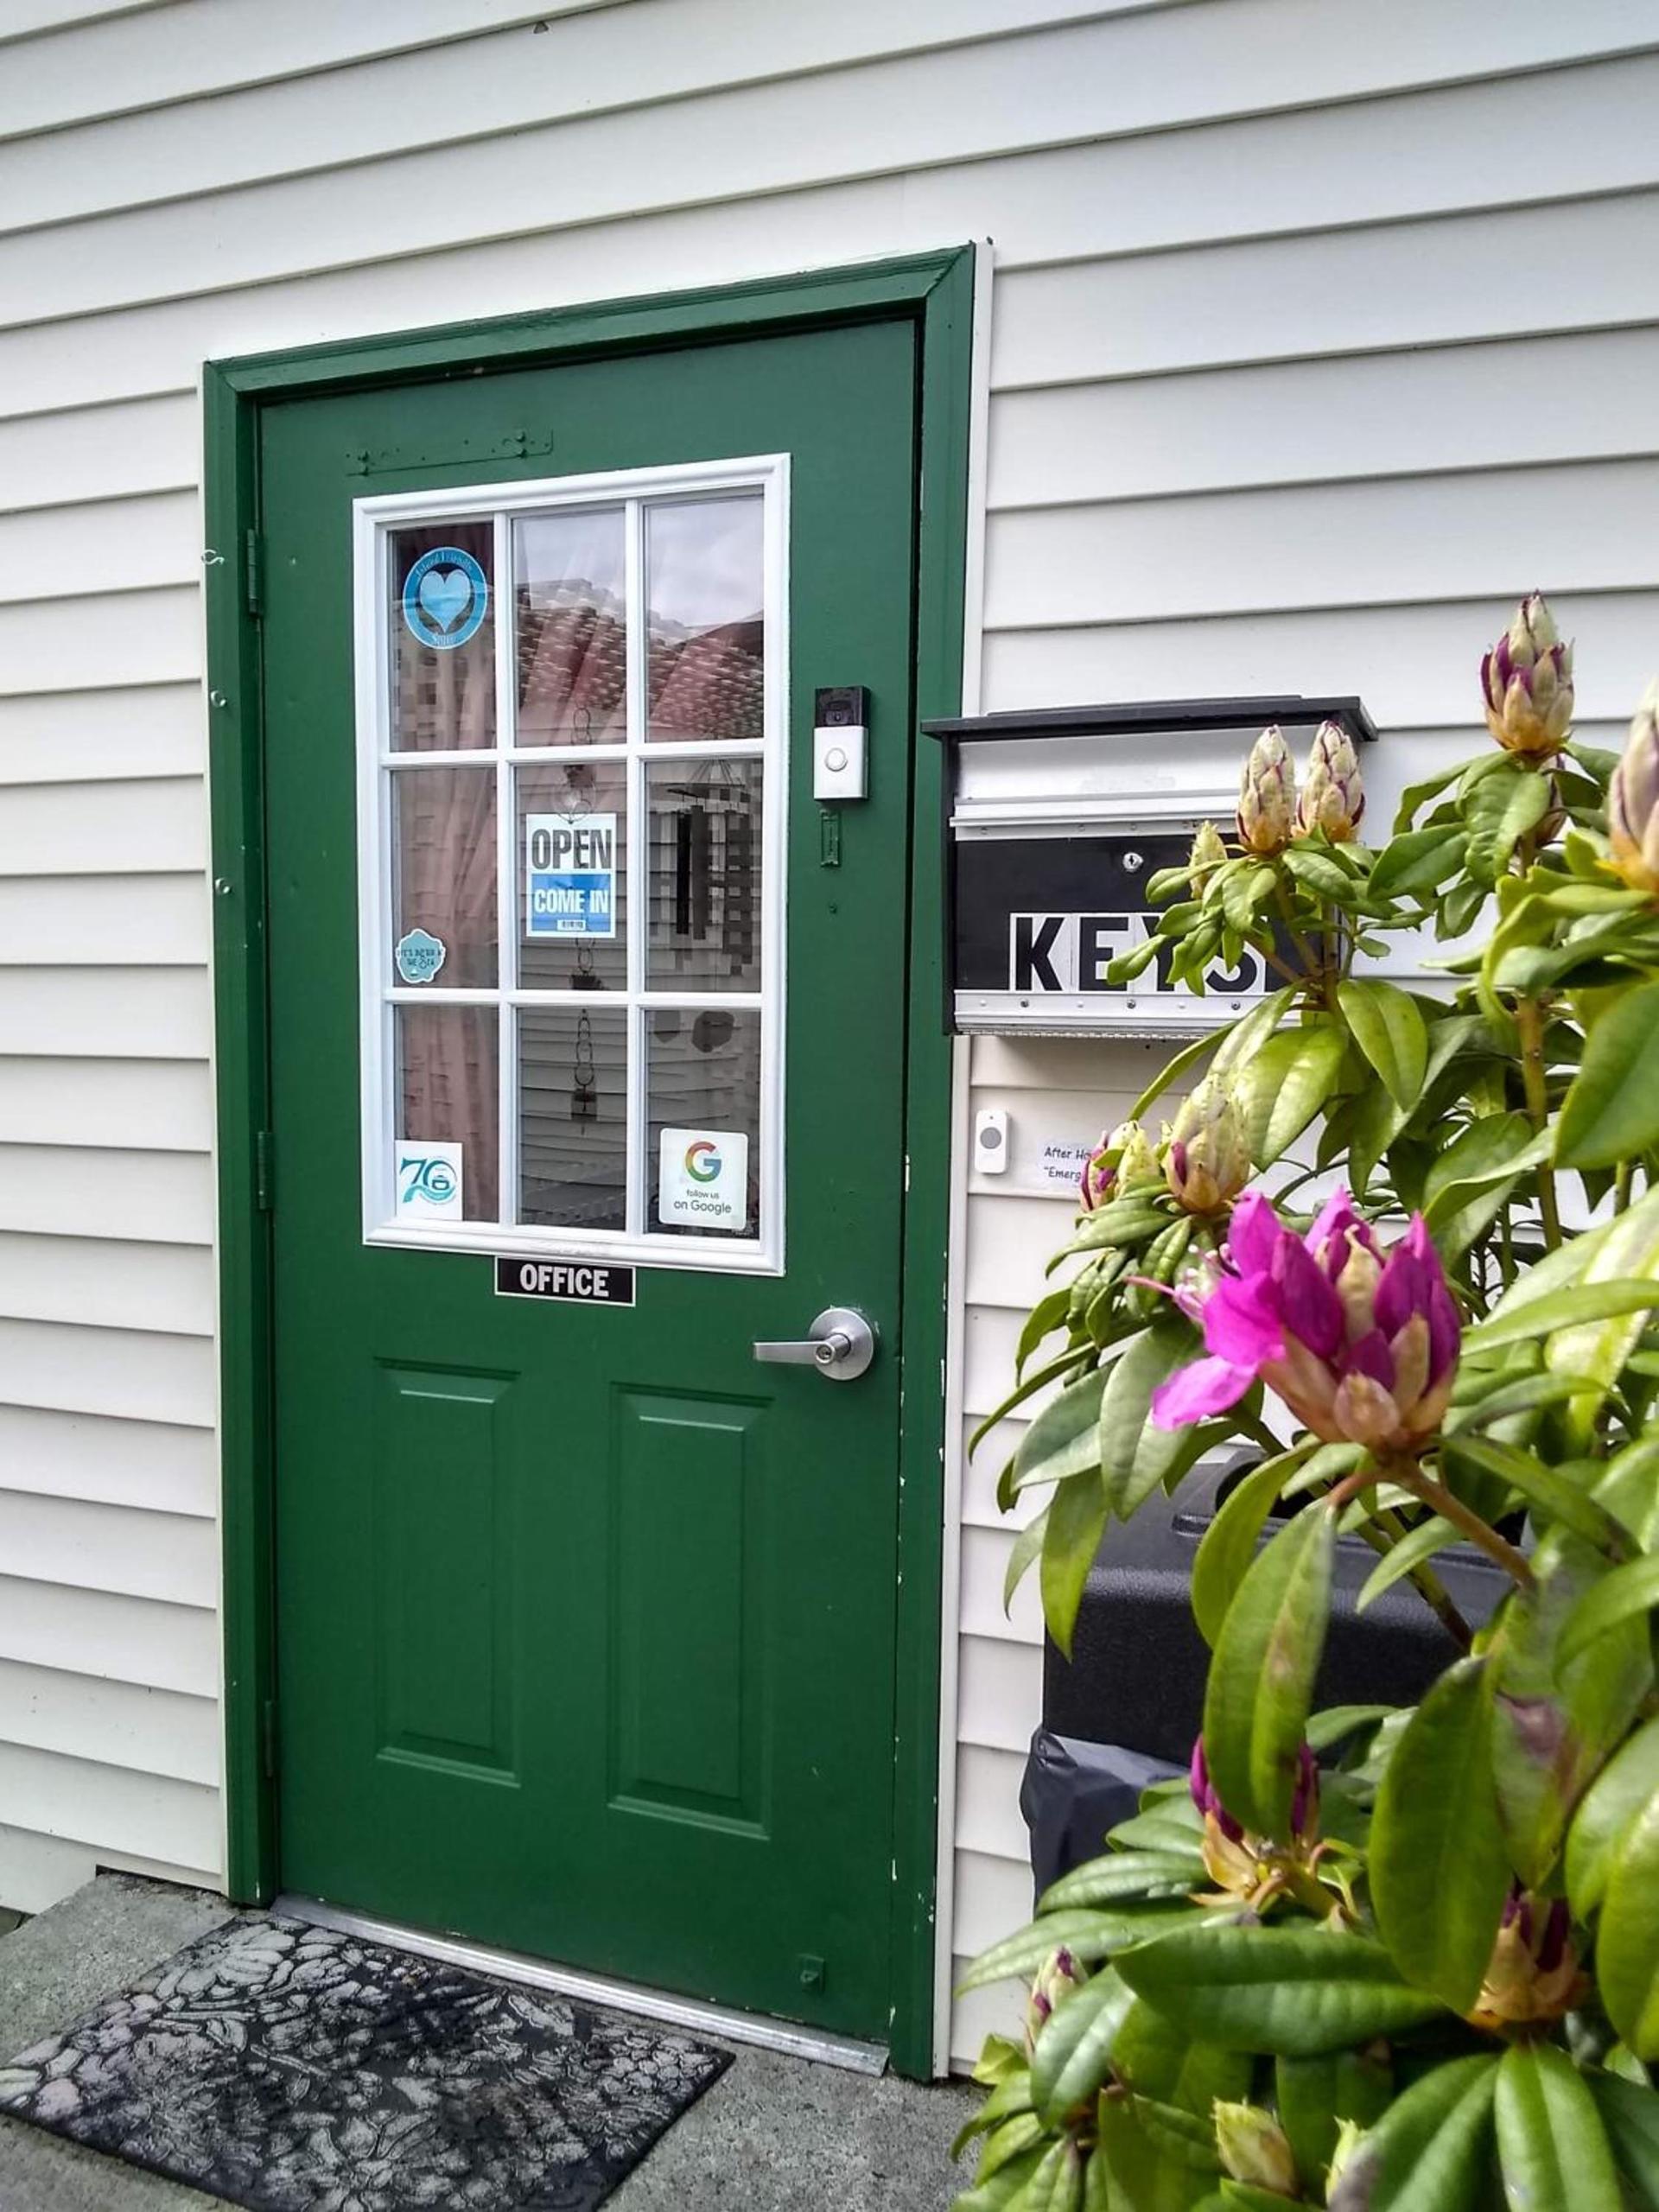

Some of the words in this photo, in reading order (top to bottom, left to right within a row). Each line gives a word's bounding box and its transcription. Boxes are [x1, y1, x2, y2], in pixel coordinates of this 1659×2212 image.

[531, 829, 612, 870] OPEN
[535, 888, 585, 914] COME
[589, 889, 609, 914] IN
[1044, 1146, 1072, 1160] After
[1076, 1149, 1092, 1160] Ho
[686, 1188, 709, 1198] follow
[673, 1200, 688, 1210] on
[690, 1200, 732, 1216] Google
[519, 1263, 609, 1297] OFFICE
